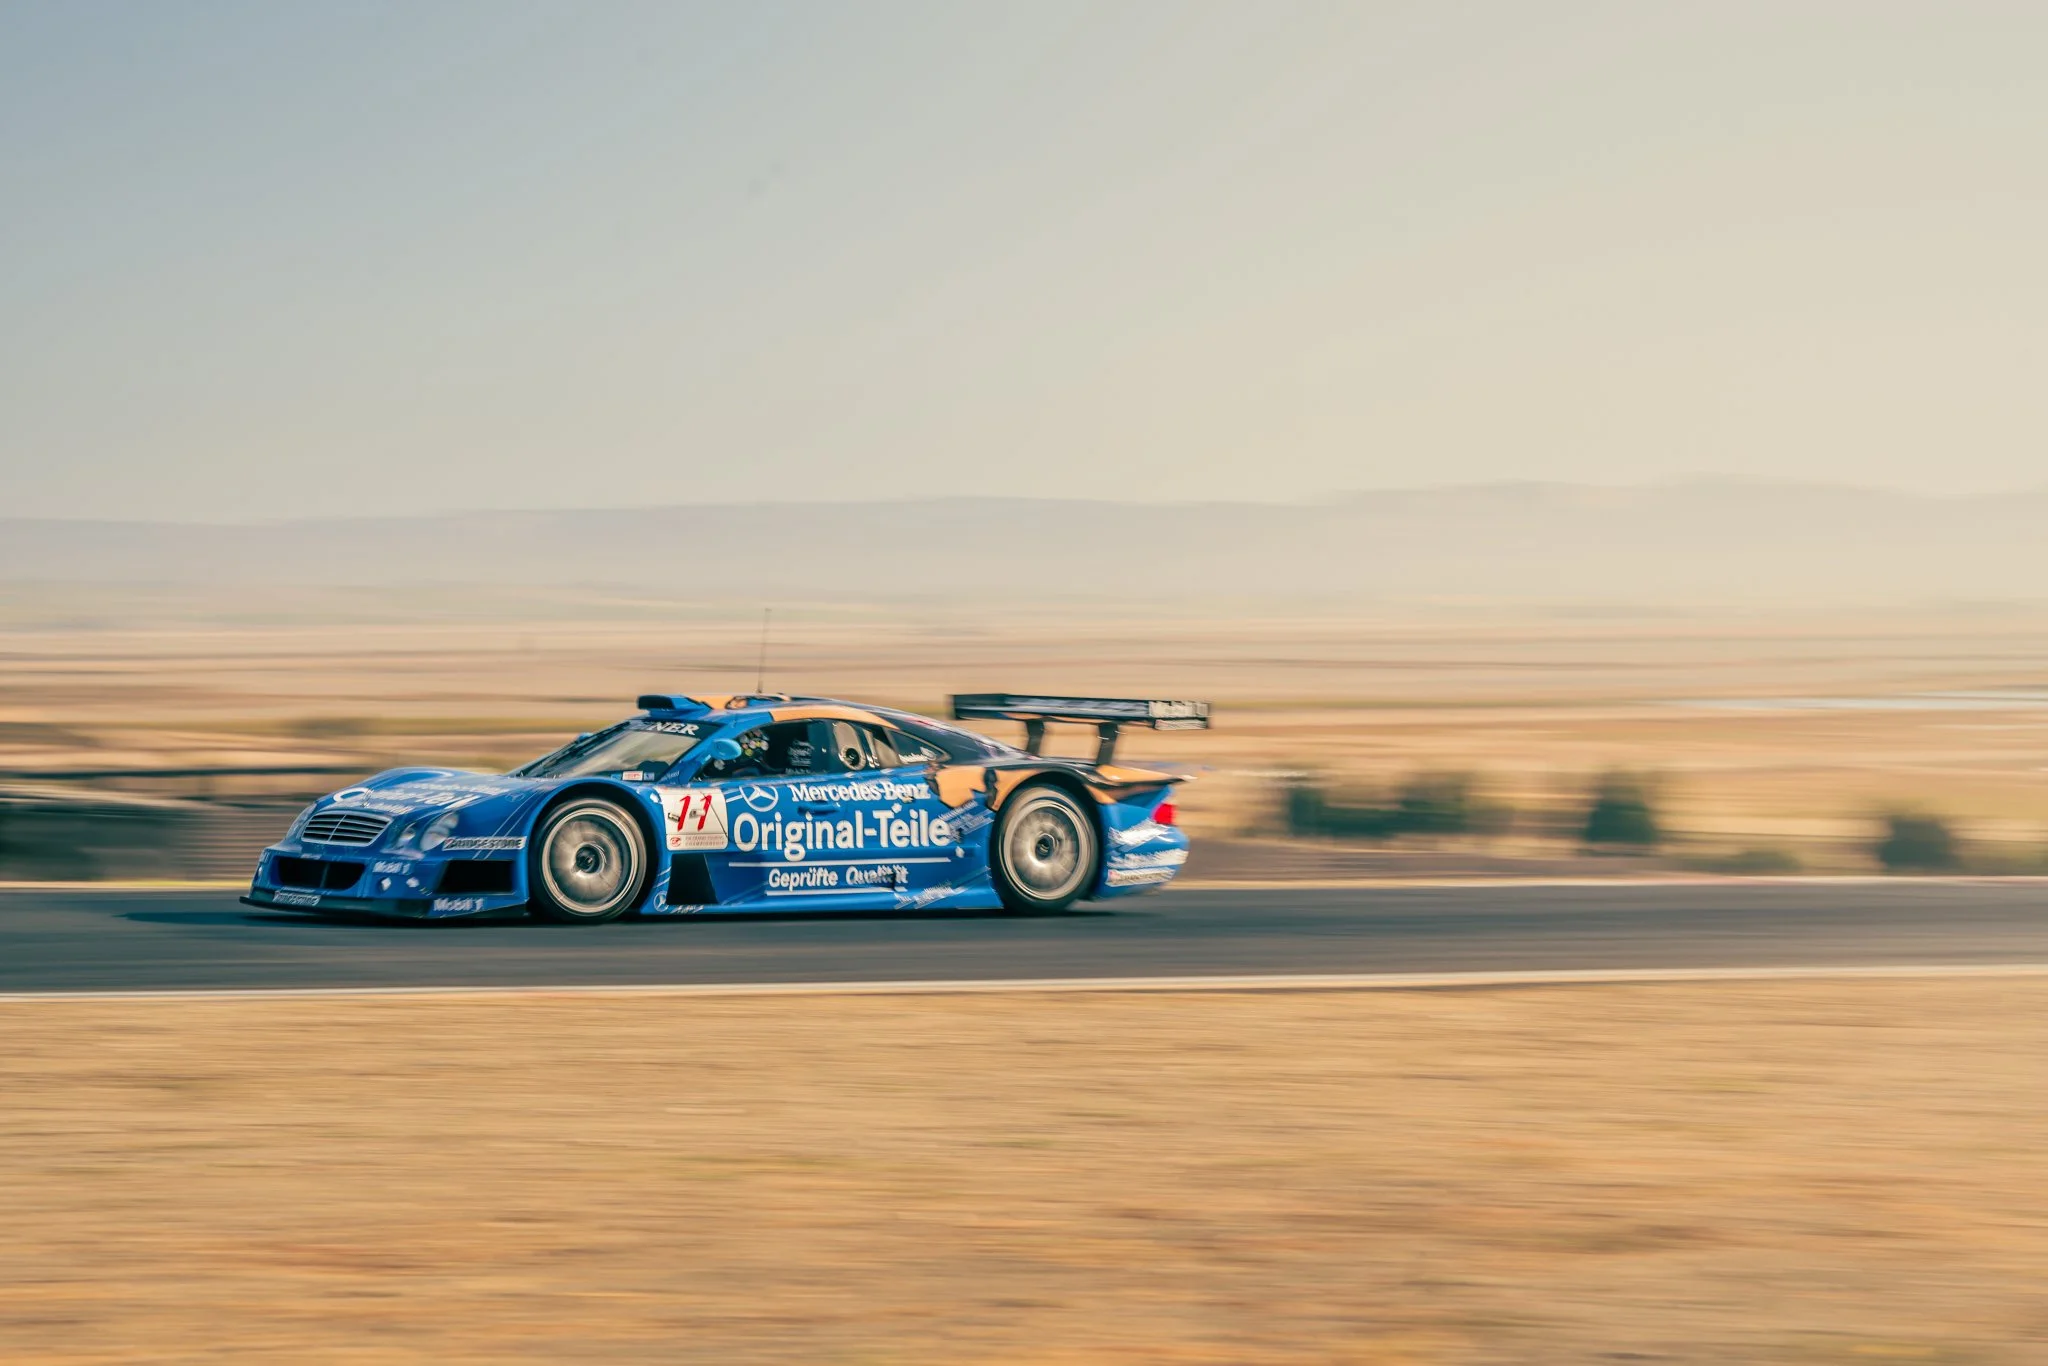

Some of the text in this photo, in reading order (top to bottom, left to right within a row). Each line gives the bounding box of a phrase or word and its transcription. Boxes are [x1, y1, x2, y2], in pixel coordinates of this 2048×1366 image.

[787, 782, 931, 802] Mercedes-Benz
[677, 795, 712, 832] 11
[733, 808, 950, 862] Original-Teile
[768, 867, 839, 892] Geprüfte
[433, 898, 474, 911] Mobil
